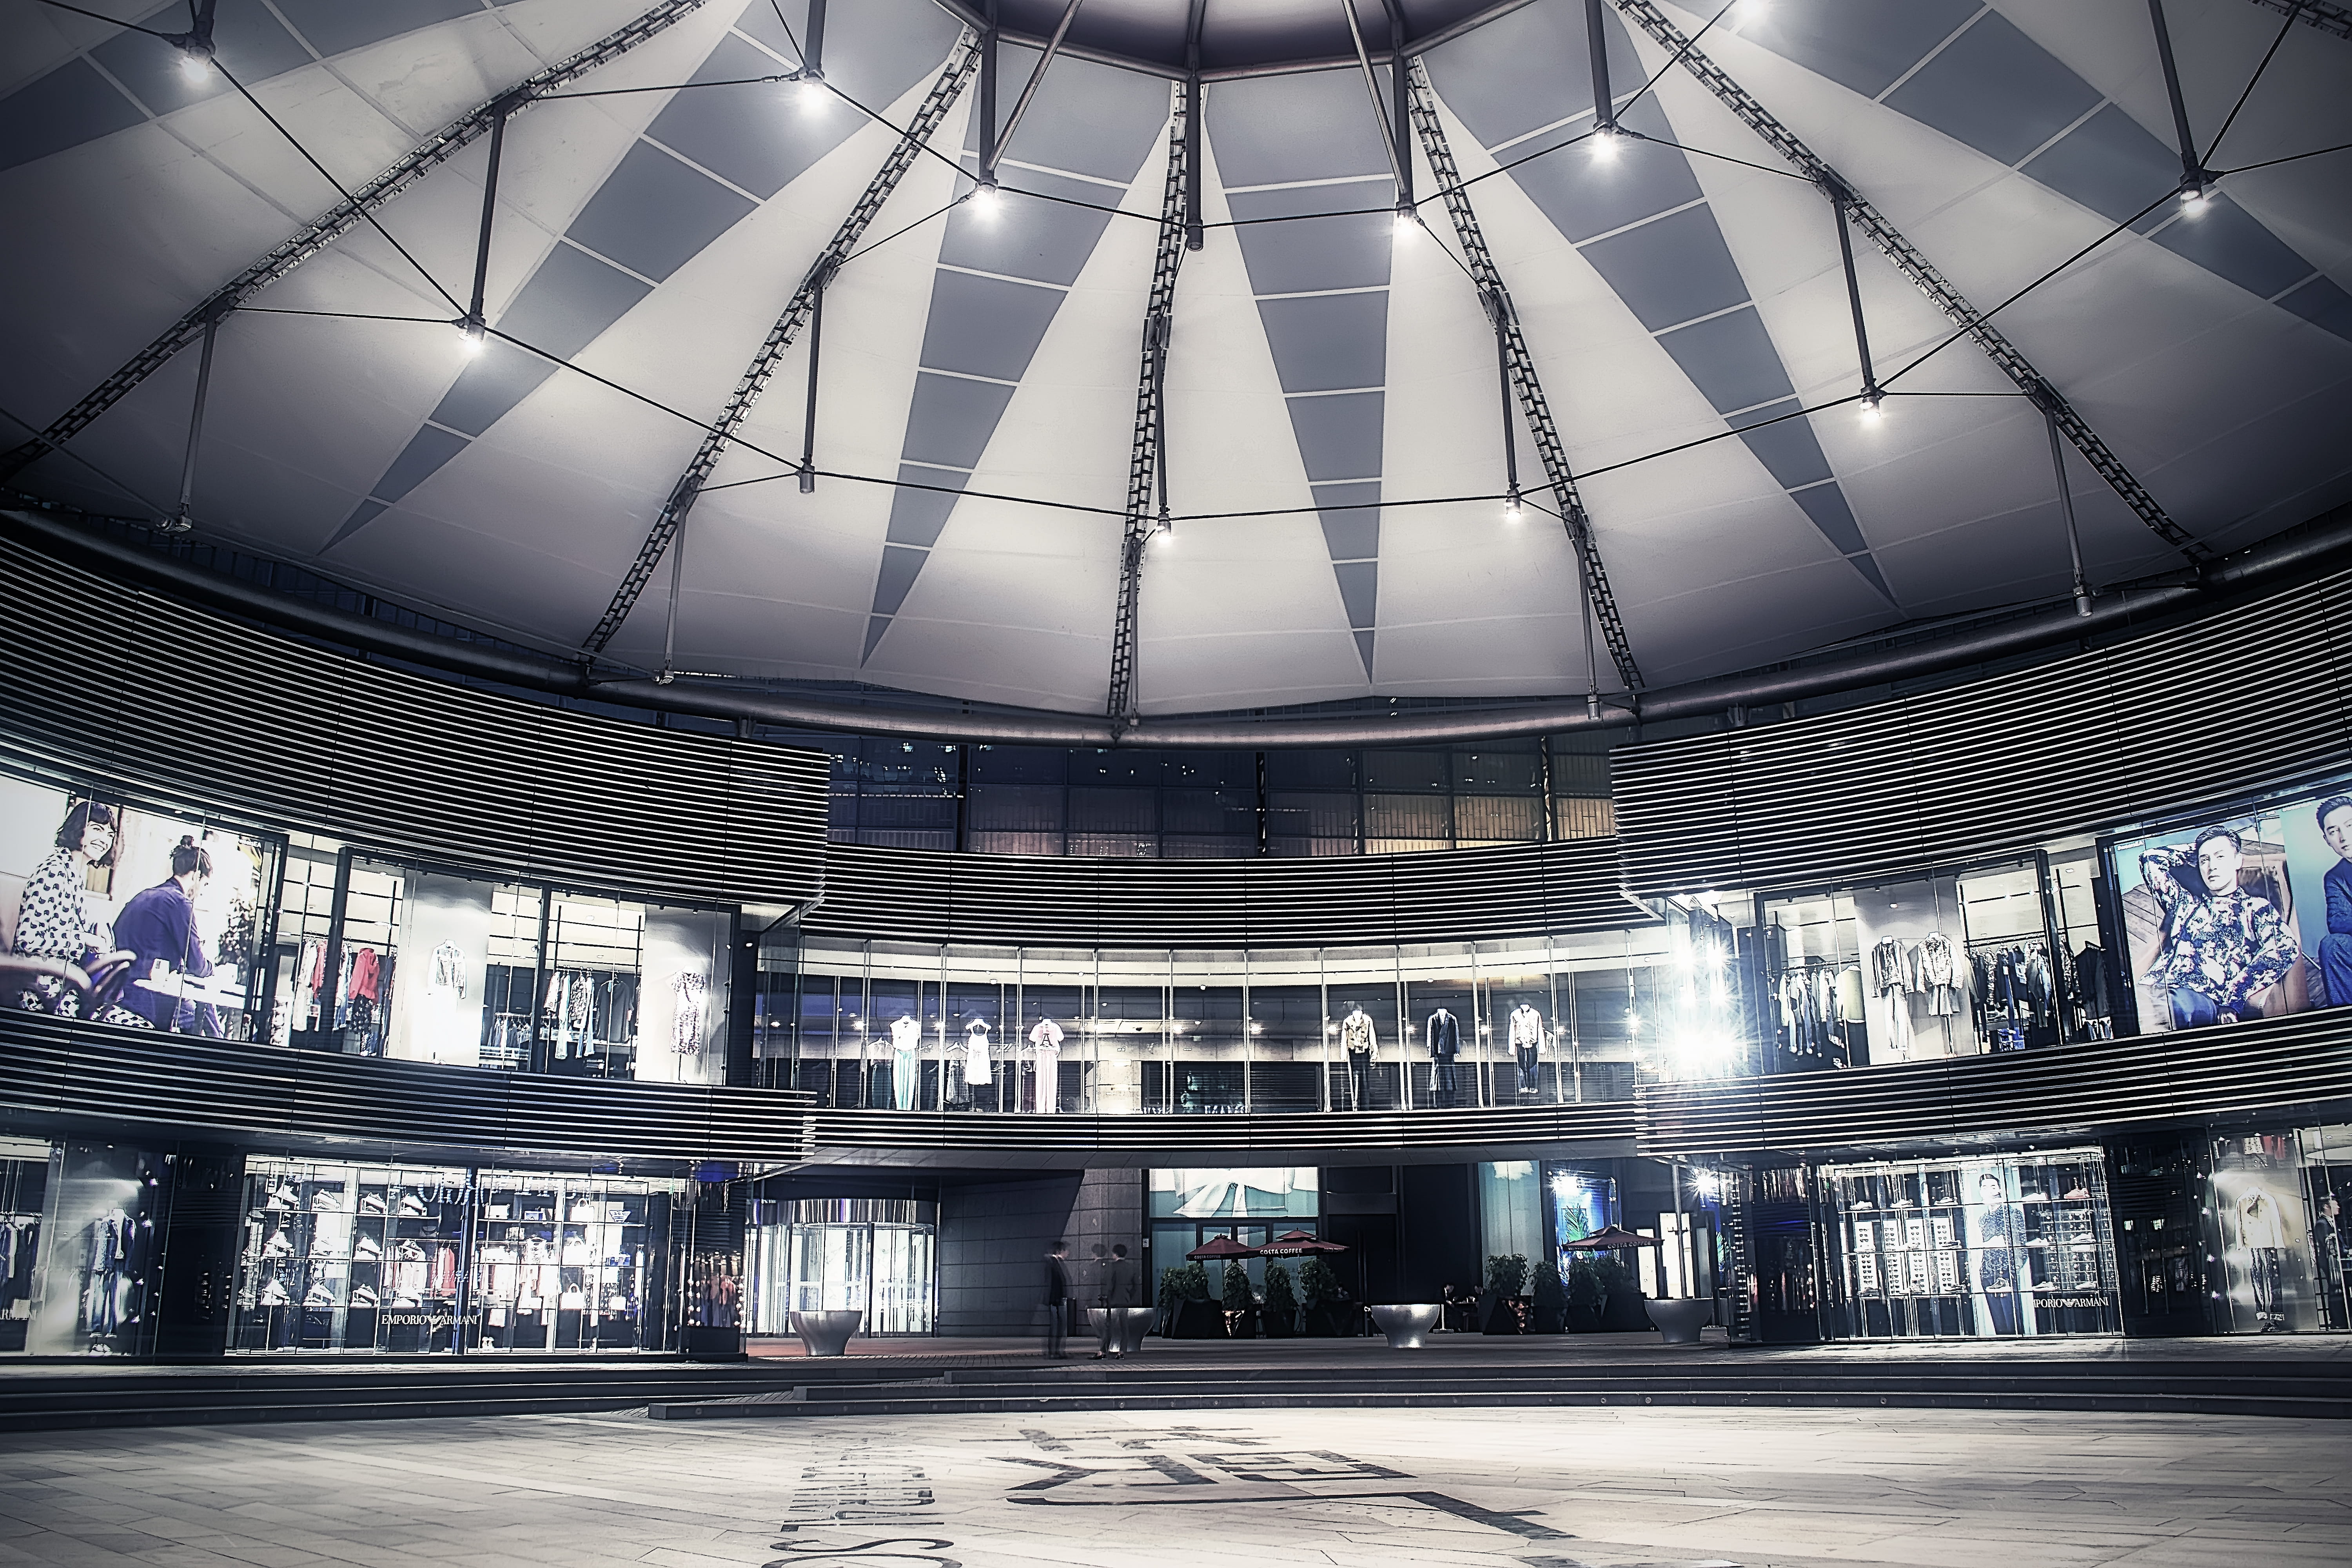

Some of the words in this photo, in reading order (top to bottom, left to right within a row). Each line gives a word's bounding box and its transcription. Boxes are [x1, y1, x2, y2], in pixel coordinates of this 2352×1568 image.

[1040, 1033, 1053, 1046] A
[2033, 1299, 2062, 1308] PORIO
[2074, 1297, 2109, 1307] ARMANI
[381, 1315, 427, 1324] EMPORIO
[441, 1315, 477, 1325] ARMANI
[780, 1464, 944, 1532] CENTRAL
